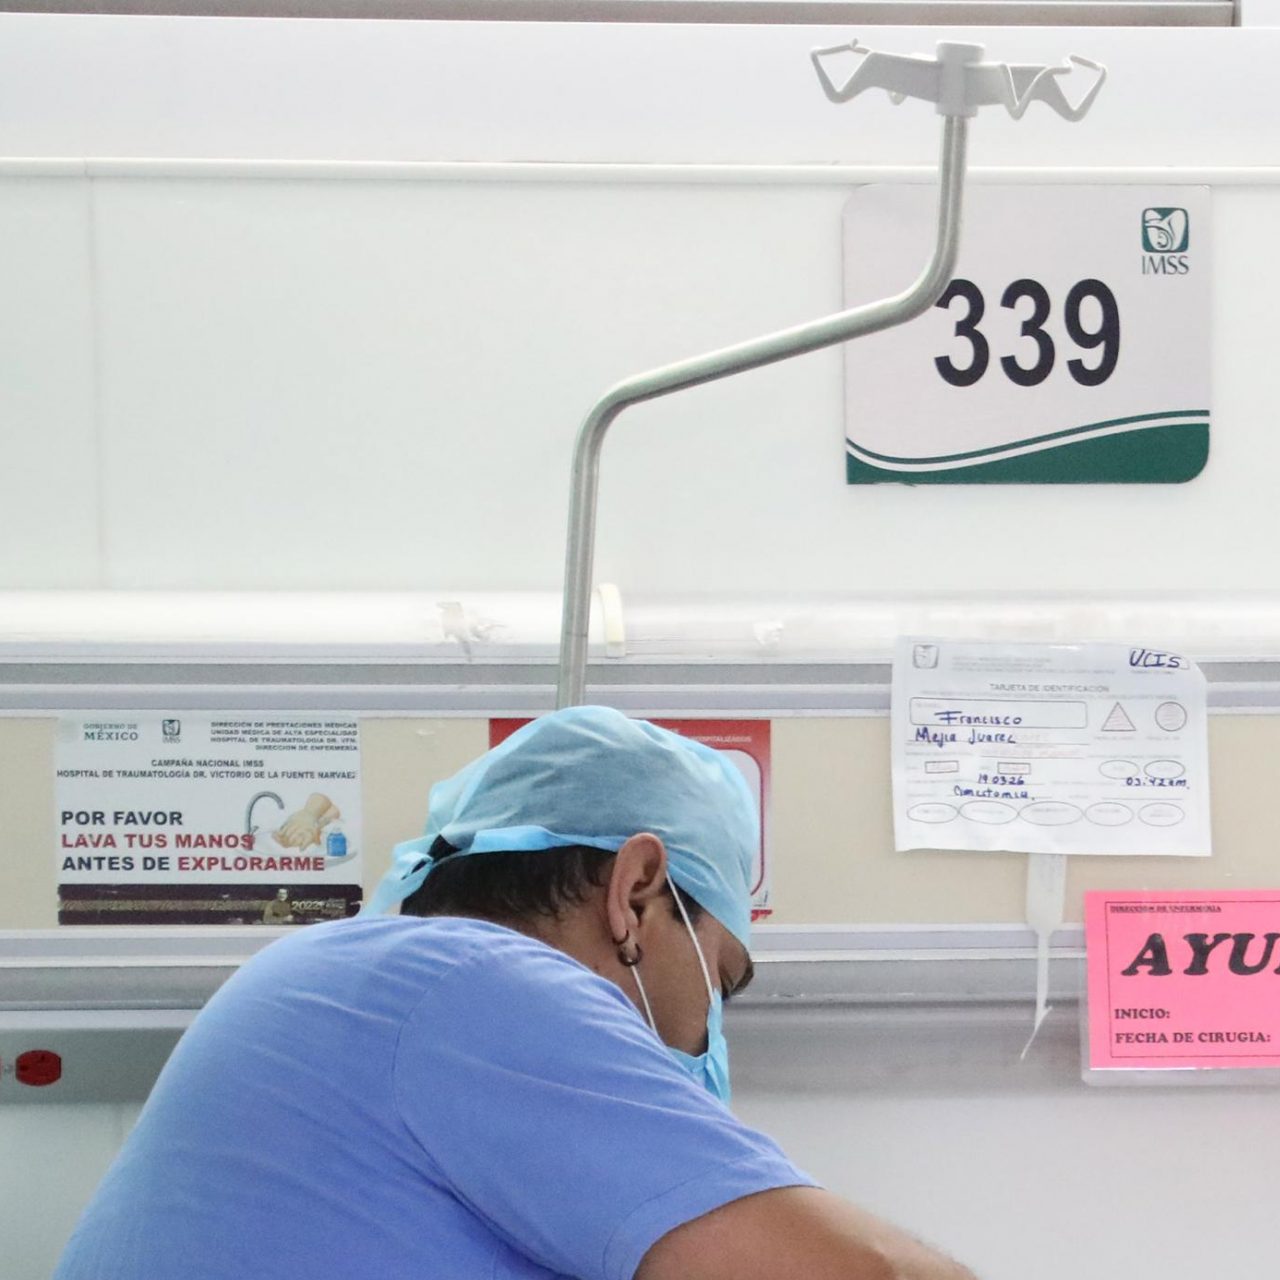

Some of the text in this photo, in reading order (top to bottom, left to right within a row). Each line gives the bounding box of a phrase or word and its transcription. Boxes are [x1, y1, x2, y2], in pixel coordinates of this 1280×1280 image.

[1141, 255, 1190, 275] IMSS
[934, 278, 1120, 387] 339
[1129, 649, 1182, 668] UCIS
[84, 729, 139, 741] MÉXICO
[151, 758, 265, 768] CAMPAÑA NACIONAL IMSS
[56, 770, 99, 778] HOSPITAL
[102, 770, 113, 778] DE
[193, 770, 208, 779] DR.
[210, 771, 251, 779] VICTORIO
[254, 771, 265, 779] DE
[268, 771, 279, 779] LA
[281, 771, 315, 780] FUENTE
[61, 811, 184, 826] POR FAVOR
[61, 833, 255, 851] LAVA TUS MANOS
[62, 856, 326, 872] ANTES DE EXPLORARME
[1114, 1008, 1170, 1020] INICIO:
[1115, 1032, 1169, 1044] FECHA
[1173, 1032, 1194, 1044] DE
